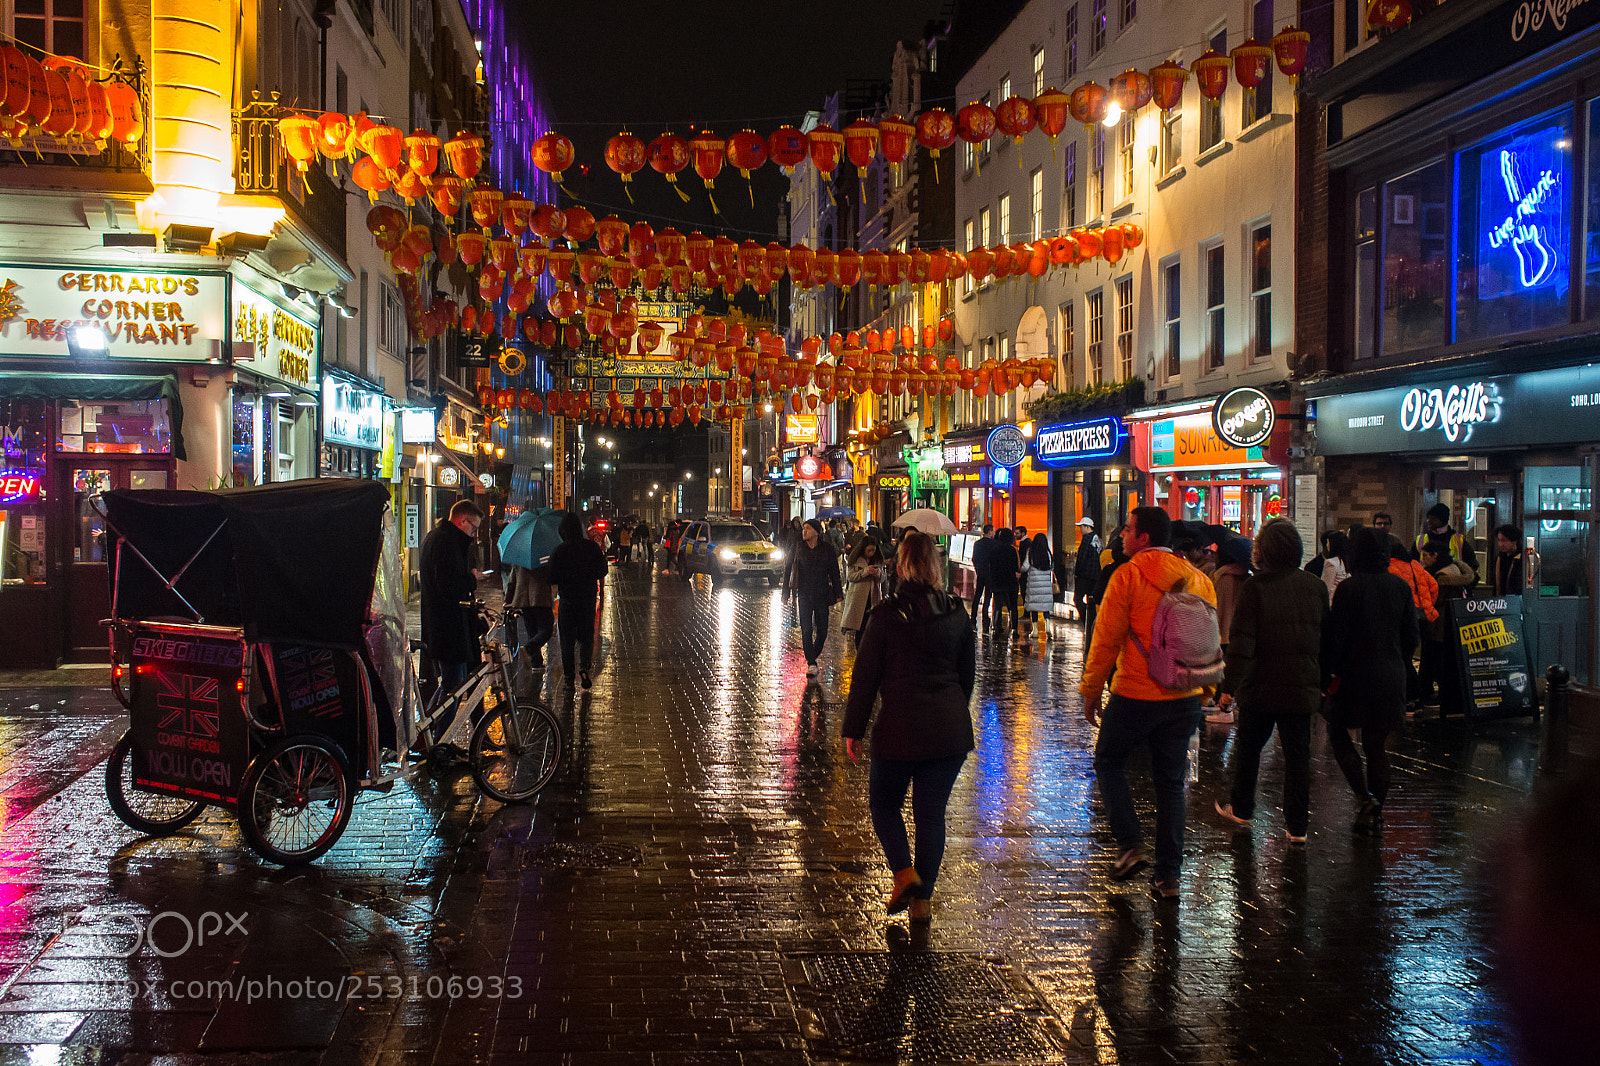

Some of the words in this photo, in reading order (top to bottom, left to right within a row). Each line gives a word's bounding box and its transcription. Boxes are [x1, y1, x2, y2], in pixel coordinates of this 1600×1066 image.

[60, 272, 200, 296] GERRARD'S
[82, 298, 185, 321] CORNER
[464, 343, 482, 357] 22
[1368, 415, 1385, 426] STREET
[1399, 382, 1490, 441] O'Neill's
[1466, 599, 1508, 614] O'Neill's
[1461, 621, 1501, 641] CALLING
[132, 636, 244, 668] SKECHERS
[290, 693, 315, 711] NOW
[315, 683, 341, 701] OPEN
[149, 749, 187, 779] NOW
[191, 757, 231, 788] OPEN
